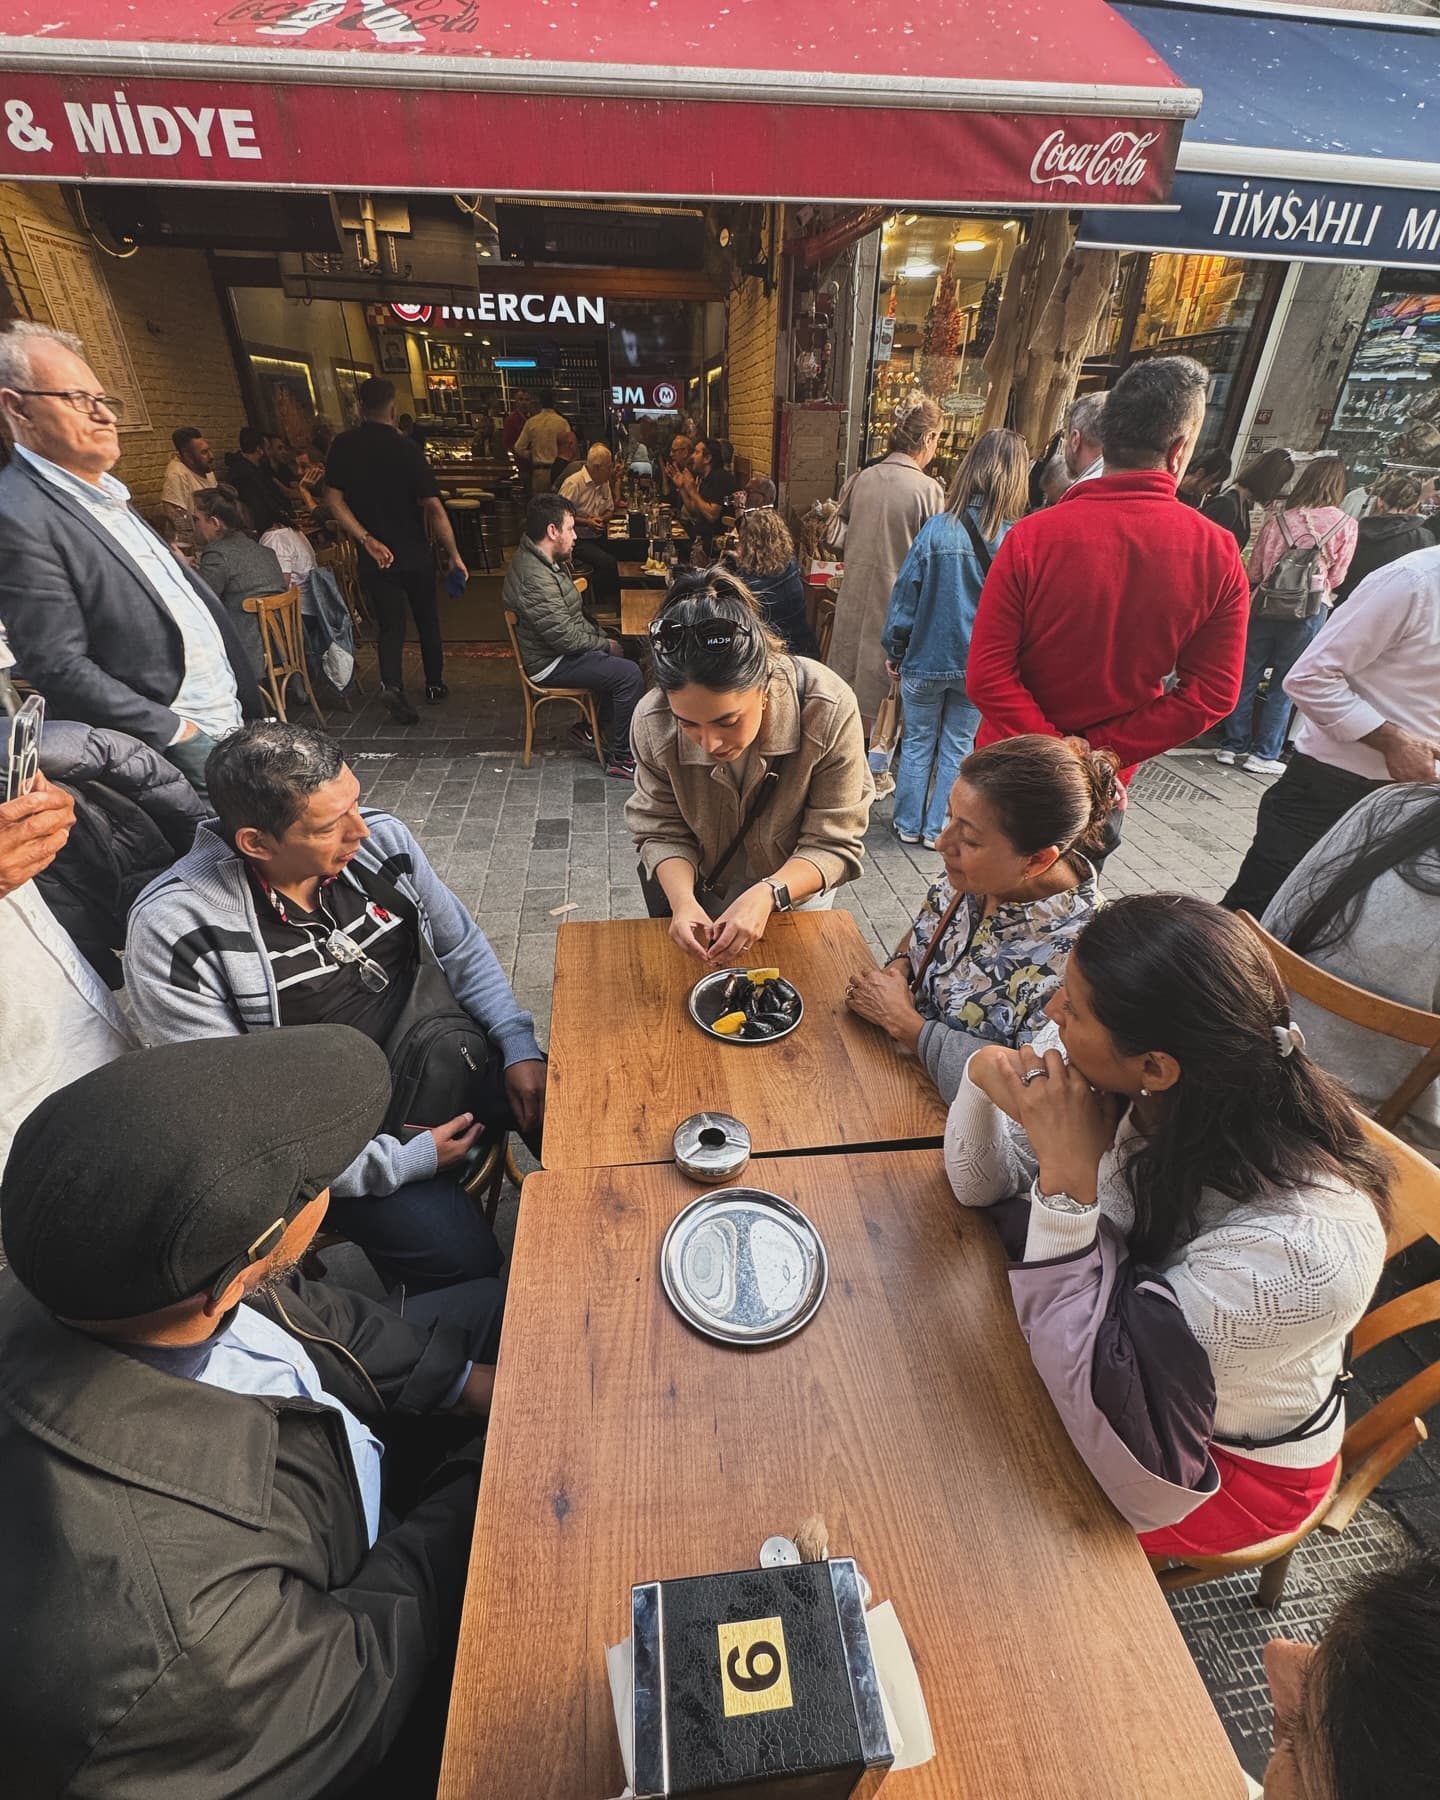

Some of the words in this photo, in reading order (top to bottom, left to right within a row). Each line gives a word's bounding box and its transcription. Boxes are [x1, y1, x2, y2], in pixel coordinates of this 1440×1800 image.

[4, 99, 54, 152] &
[63, 90, 262, 160] MİDYE
[1029, 130, 1161, 188] Coca-Cola
[1213, 181, 1383, 247] TİMSAHLI
